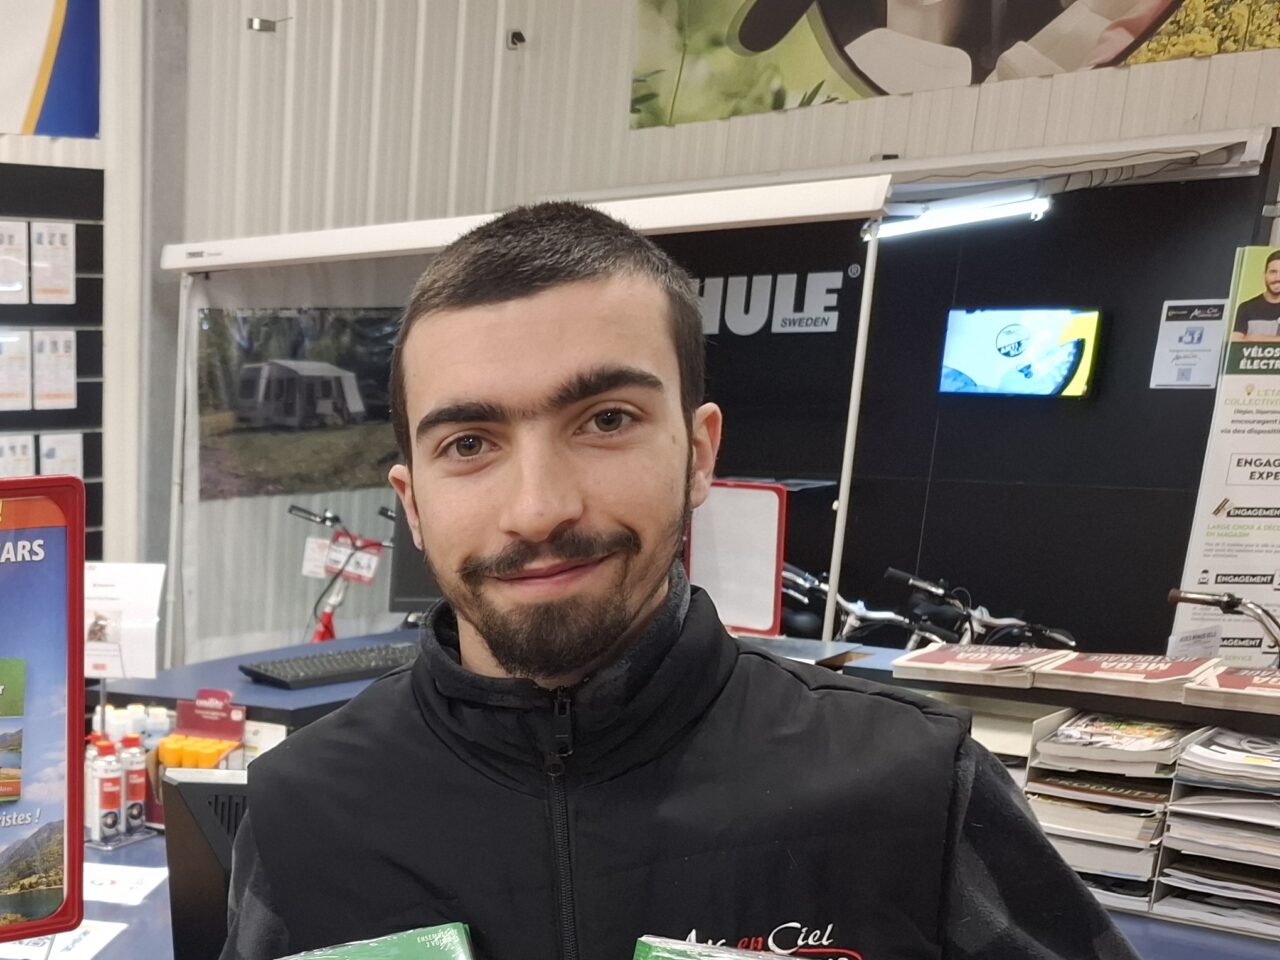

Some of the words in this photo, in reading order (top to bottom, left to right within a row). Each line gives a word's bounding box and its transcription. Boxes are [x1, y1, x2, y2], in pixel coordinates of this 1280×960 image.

[689, 271, 844, 336] HULE
[780, 316, 830, 328] SWEDEN
[1217, 575, 1273, 583] ENGAGEMENT
[1100, 661, 1172, 672] MEGA
[767, 922, 834, 954] Ciel
